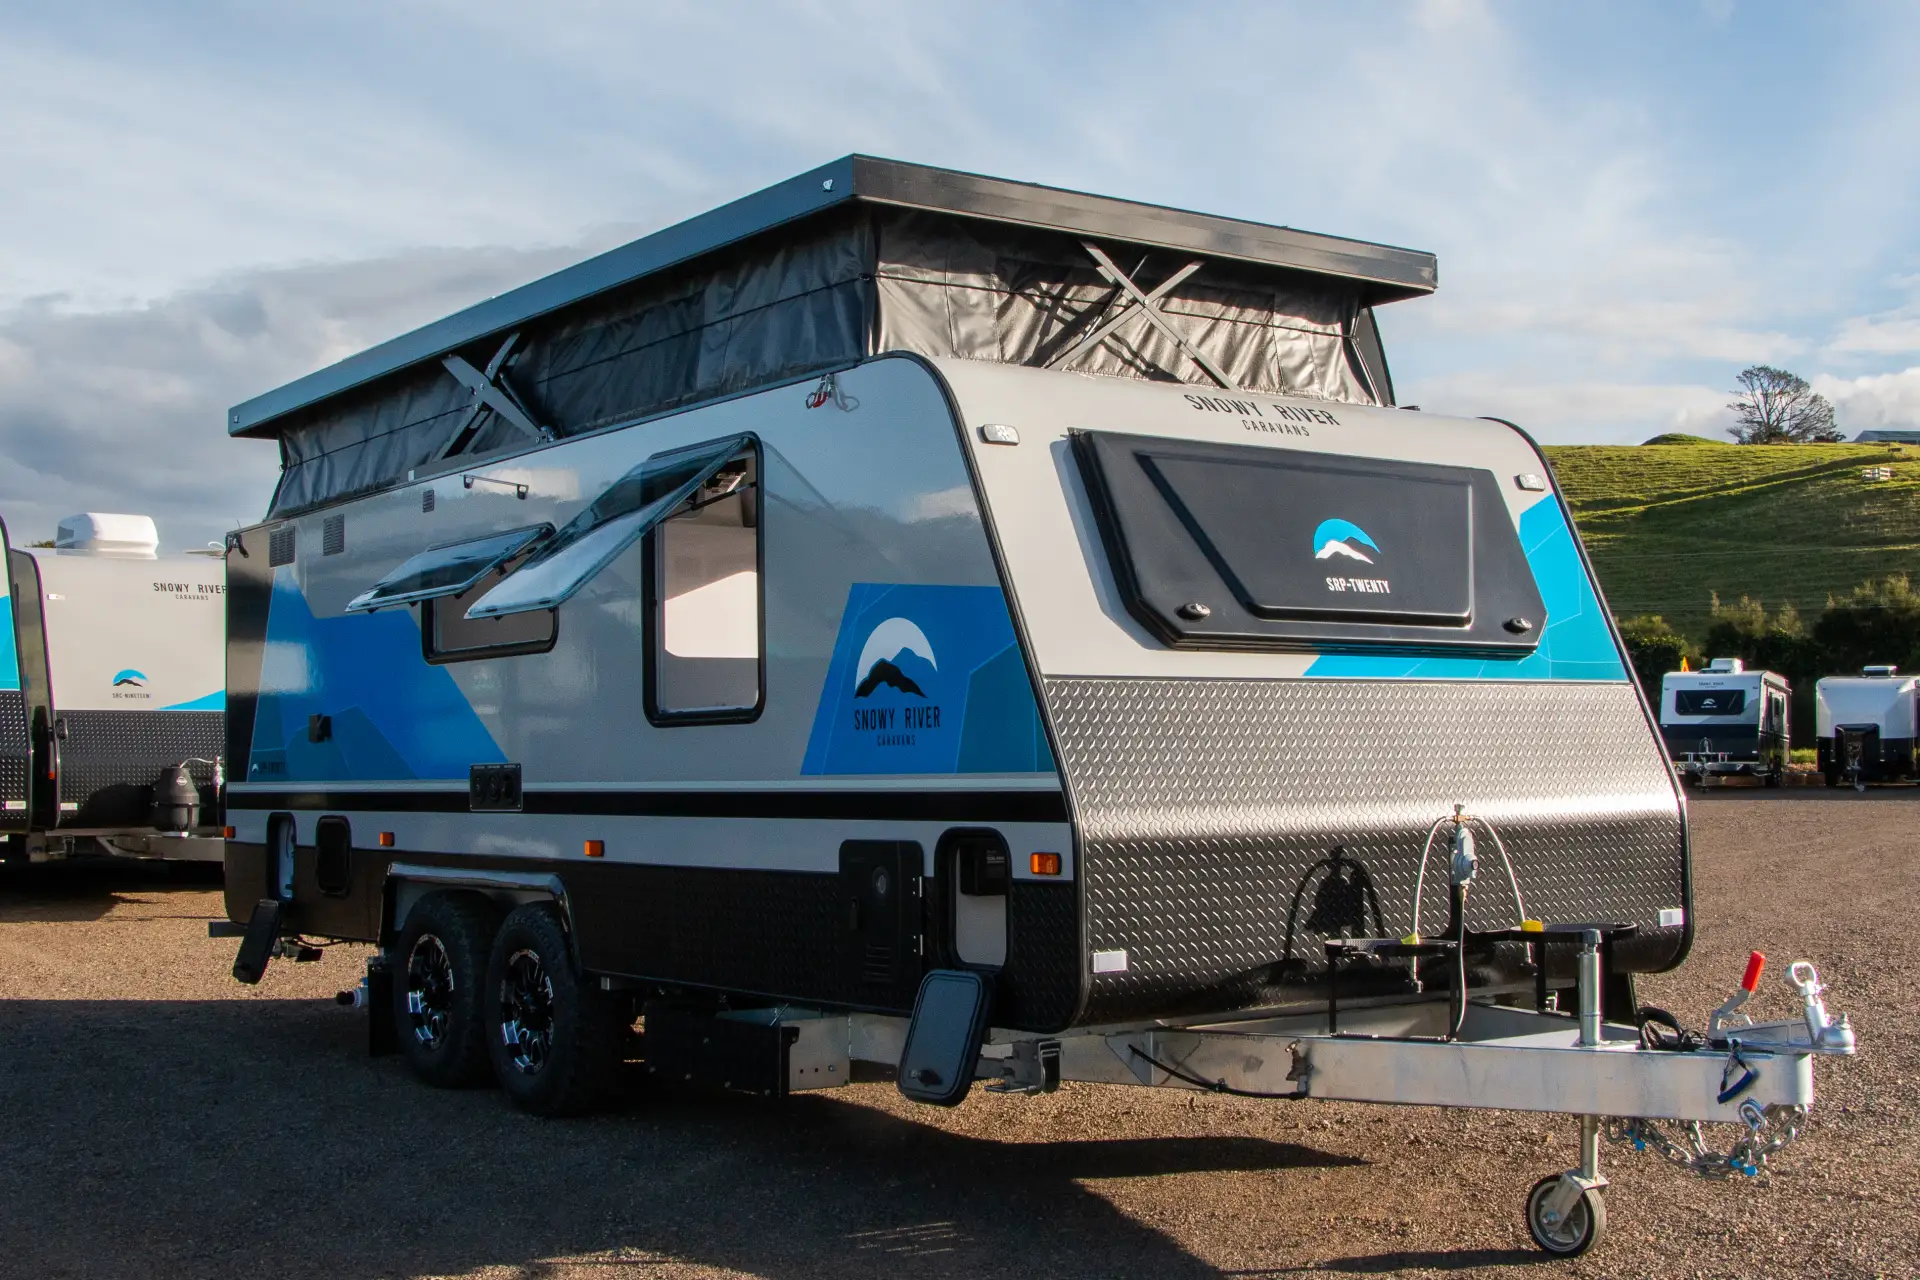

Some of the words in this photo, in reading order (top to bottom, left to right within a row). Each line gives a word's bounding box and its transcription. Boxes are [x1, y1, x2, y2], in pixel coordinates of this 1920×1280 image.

[1184, 394, 1263, 417] SNOWY
[1272, 404, 1341, 426] RIVER
[1242, 419, 1310, 437] CARAVANS
[153, 582, 189, 593] SNOWY
[197, 584, 227, 594] RIVER
[1326, 577, 1391, 594] SRP-TWENTY
[854, 708, 895, 730] SNOWY
[905, 706, 941, 729] RIVER
[877, 734, 916, 747] CARAVANS
